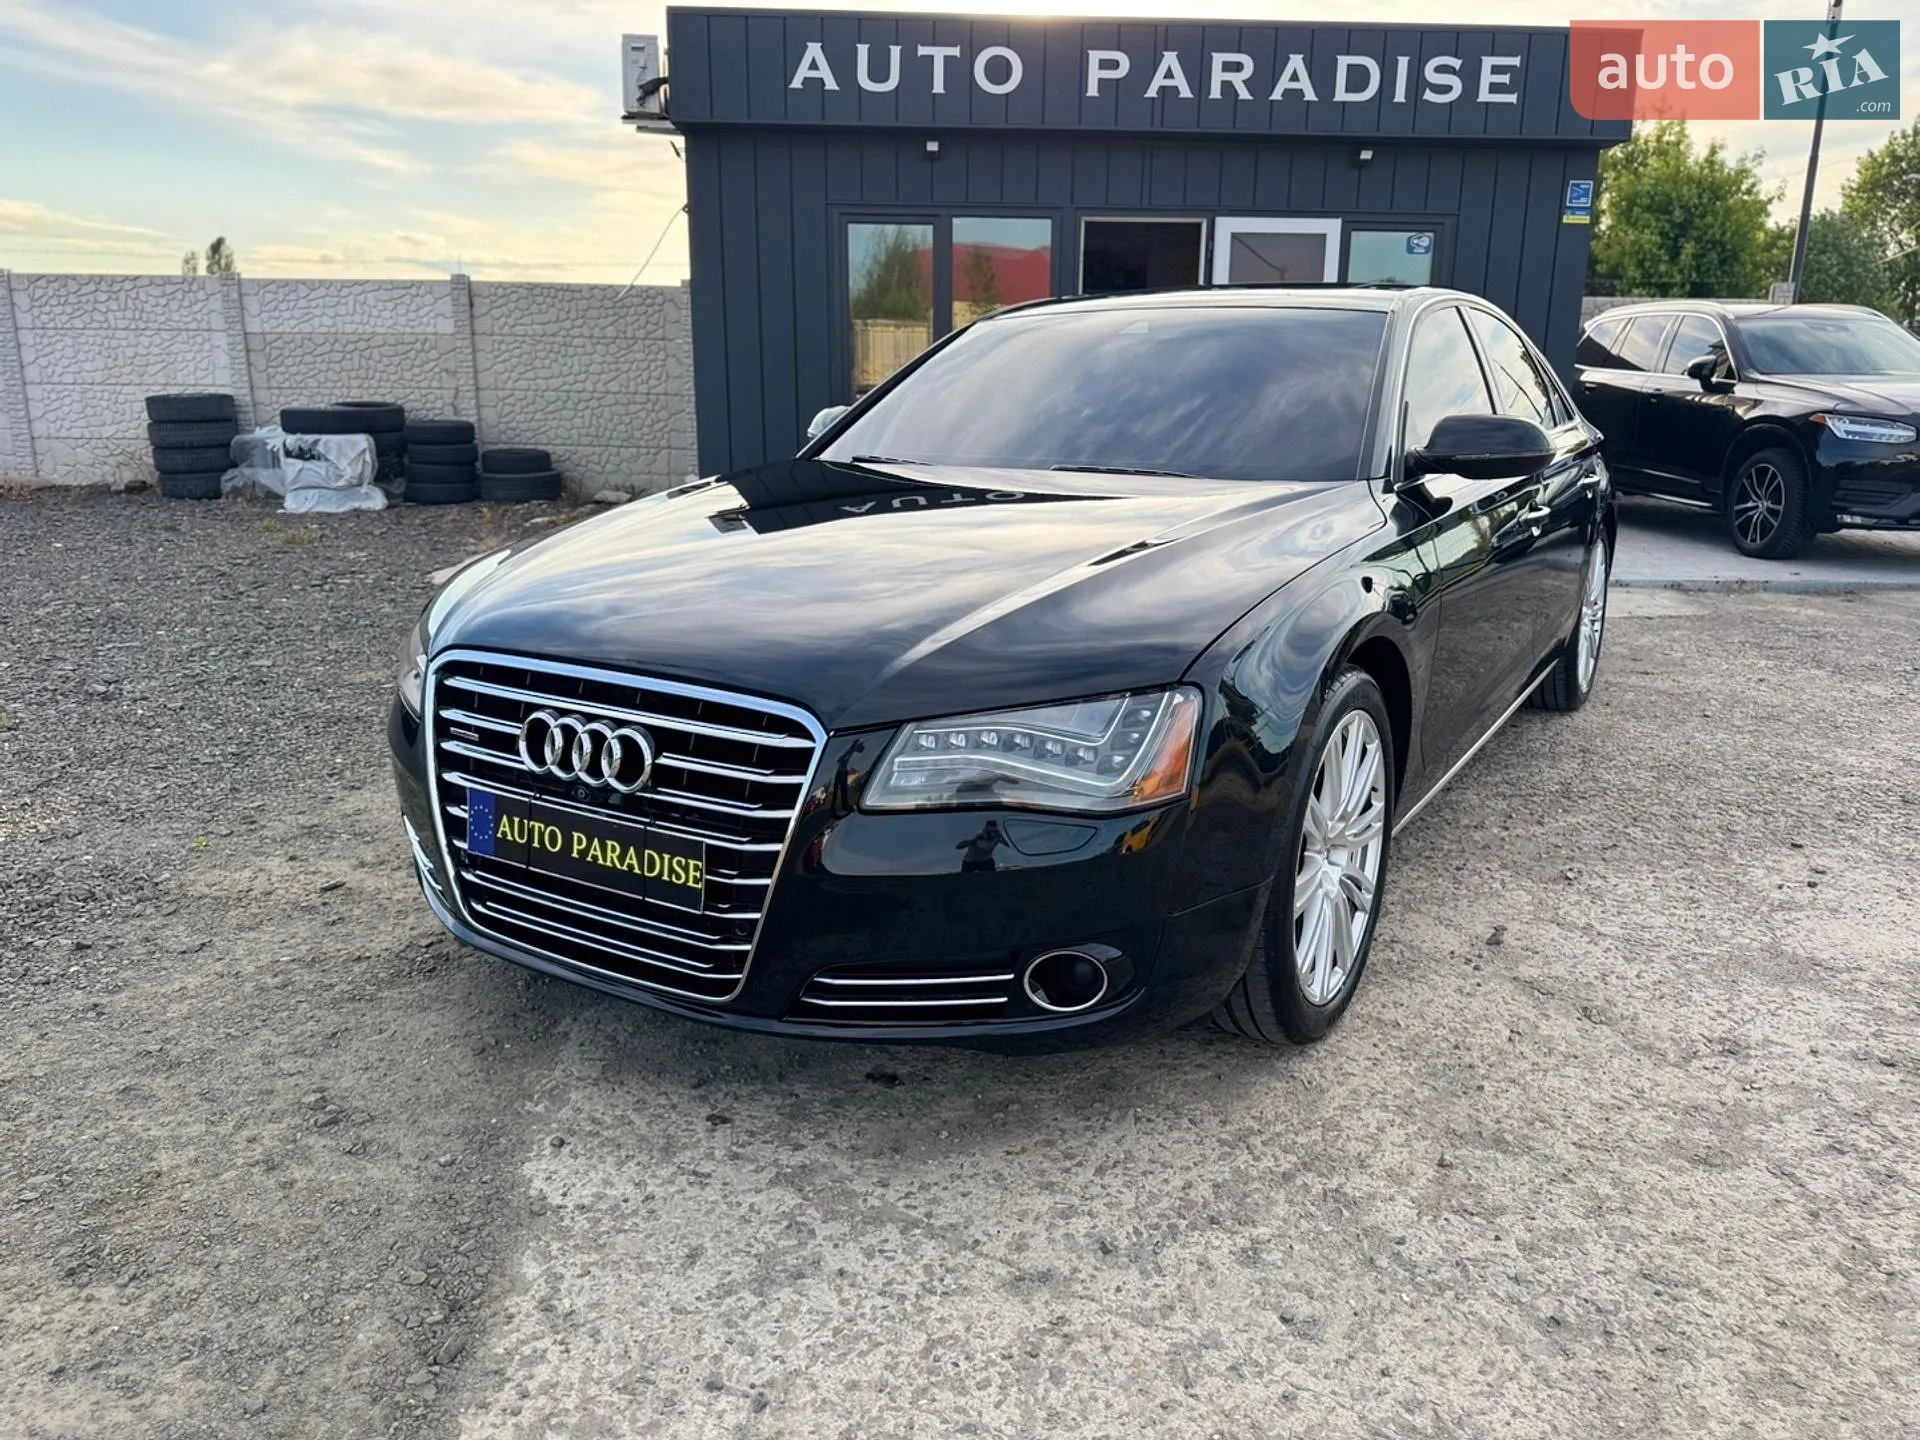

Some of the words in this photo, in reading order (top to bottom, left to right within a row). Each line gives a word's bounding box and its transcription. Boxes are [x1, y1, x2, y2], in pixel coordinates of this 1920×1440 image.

[789, 42, 1023, 95] AUTO
[1085, 49, 1521, 104] PARADISE
[497, 814, 563, 852] AUTO
[572, 832, 703, 888] PARADISE
